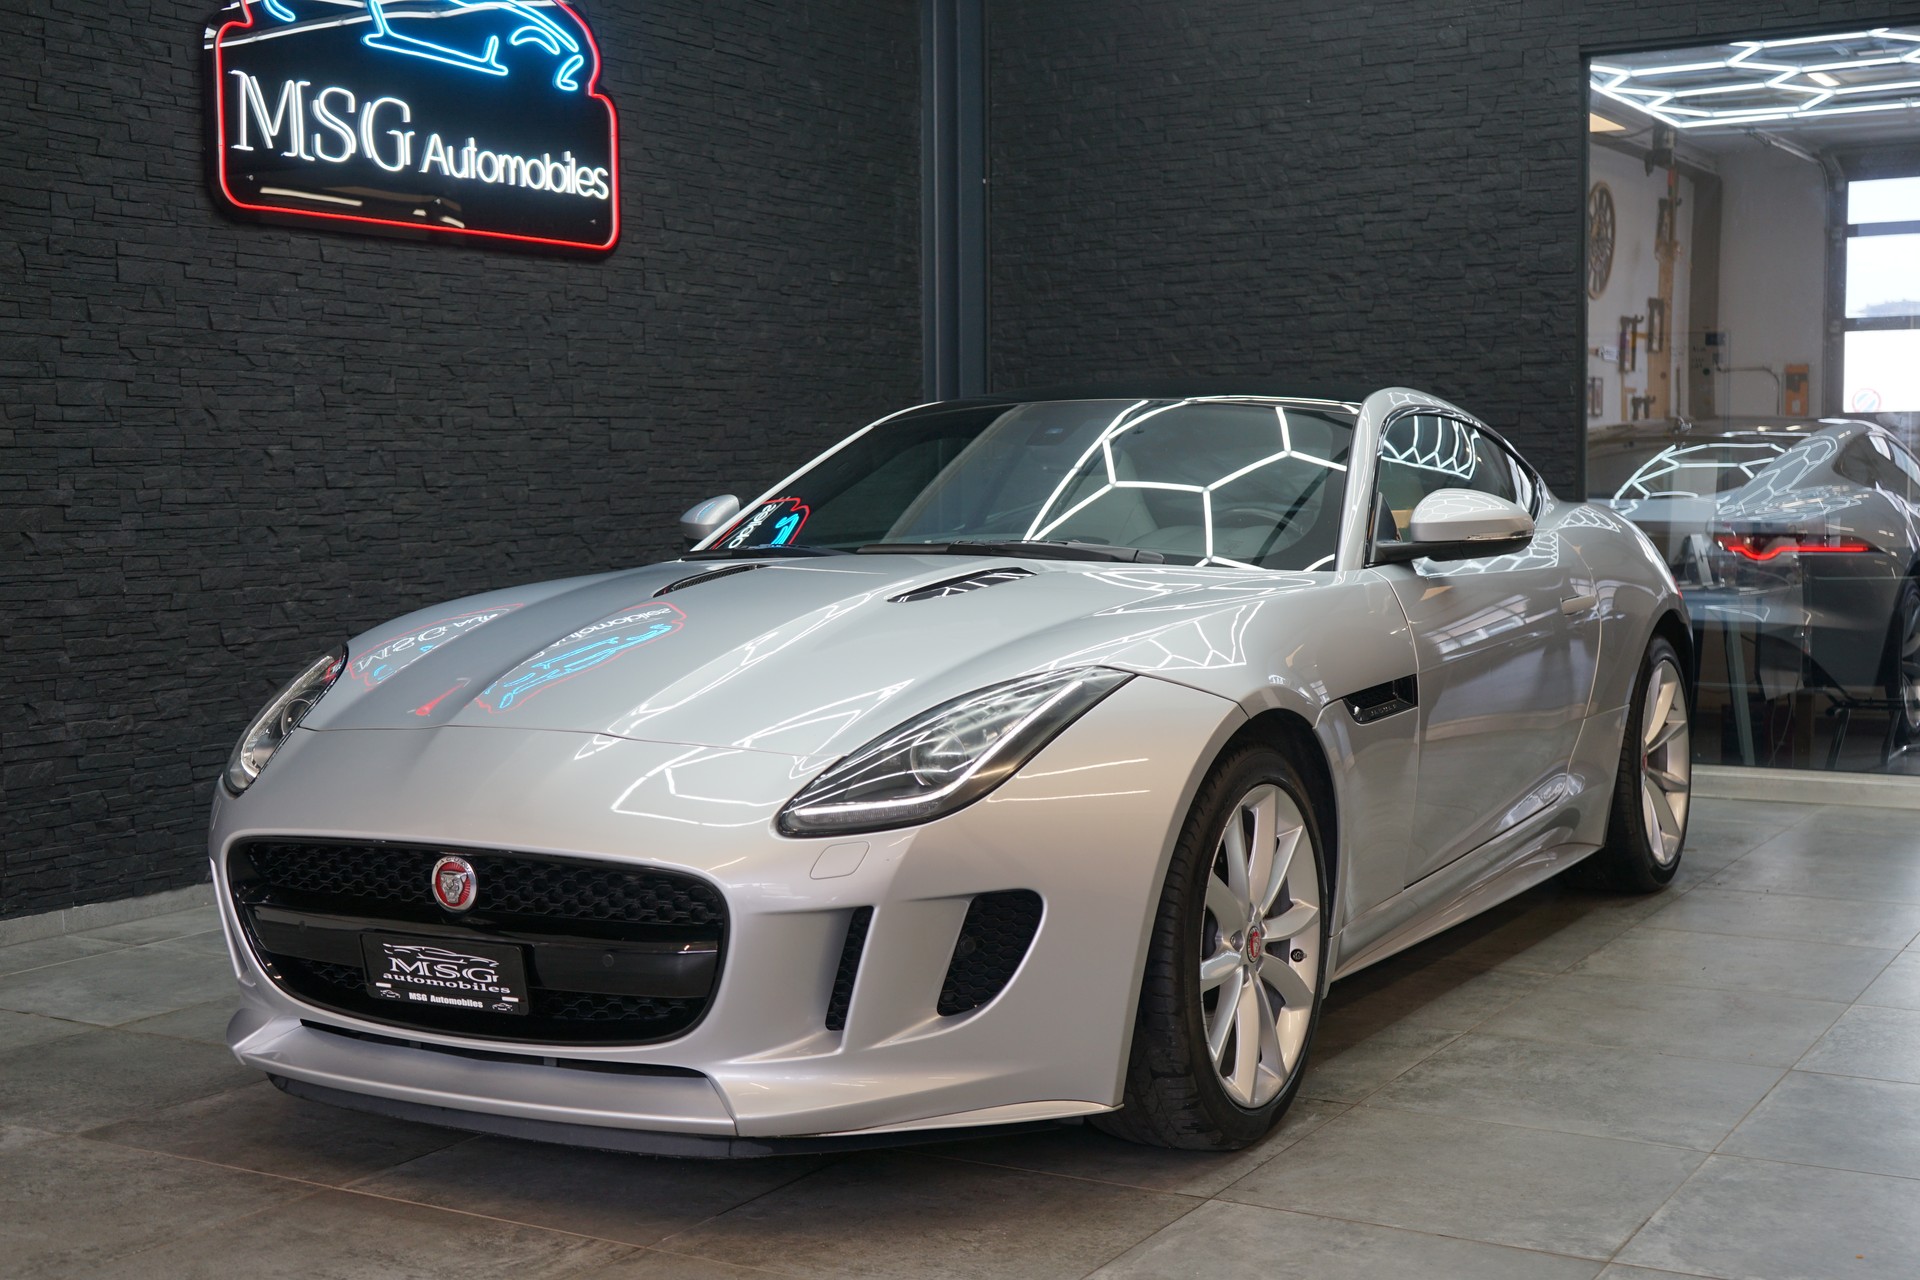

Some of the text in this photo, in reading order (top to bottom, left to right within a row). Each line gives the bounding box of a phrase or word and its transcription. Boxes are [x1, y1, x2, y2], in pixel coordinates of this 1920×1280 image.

[228, 70, 610, 200] MSG Automobiles
[388, 956, 500, 983] MSG
[382, 972, 511, 994] automobiles
[408, 991, 484, 1009] MSG Automobiles
